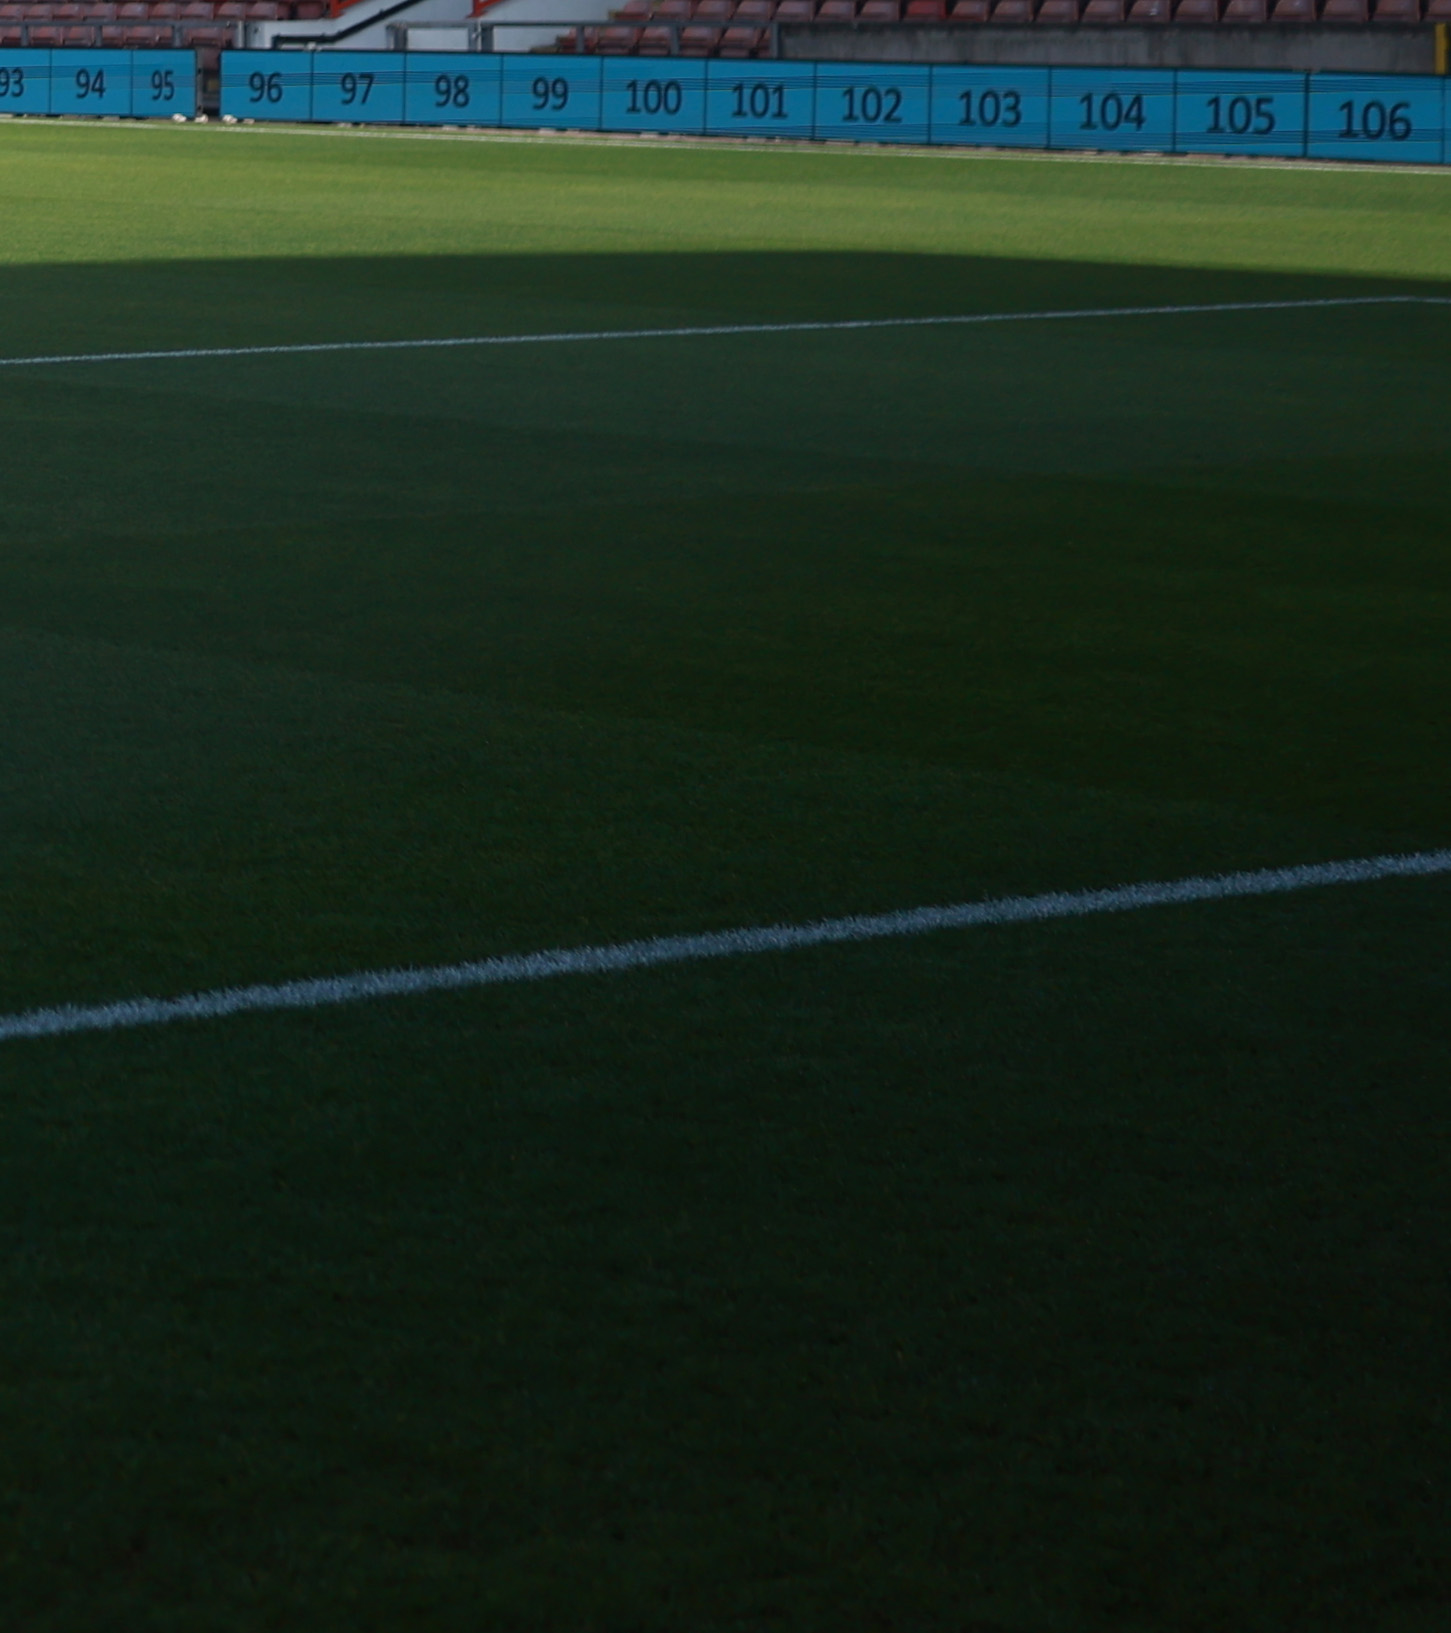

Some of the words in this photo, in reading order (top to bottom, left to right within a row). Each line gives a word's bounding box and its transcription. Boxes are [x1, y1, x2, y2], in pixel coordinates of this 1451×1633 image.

[76, 69, 105, 99] 94
[152, 70, 174, 101] 95
[248, 71, 283, 104] 96
[340, 73, 375, 105] 97
[435, 75, 469, 108] 98
[533, 77, 569, 110] 99
[626, 79, 685, 115] 100
[732, 81, 788, 118] 101
[843, 86, 901, 123] 102
[958, 90, 1021, 127] 103
[1080, 93, 1145, 130] 104
[1205, 97, 1275, 135] 105
[1339, 101, 1412, 141] 106
